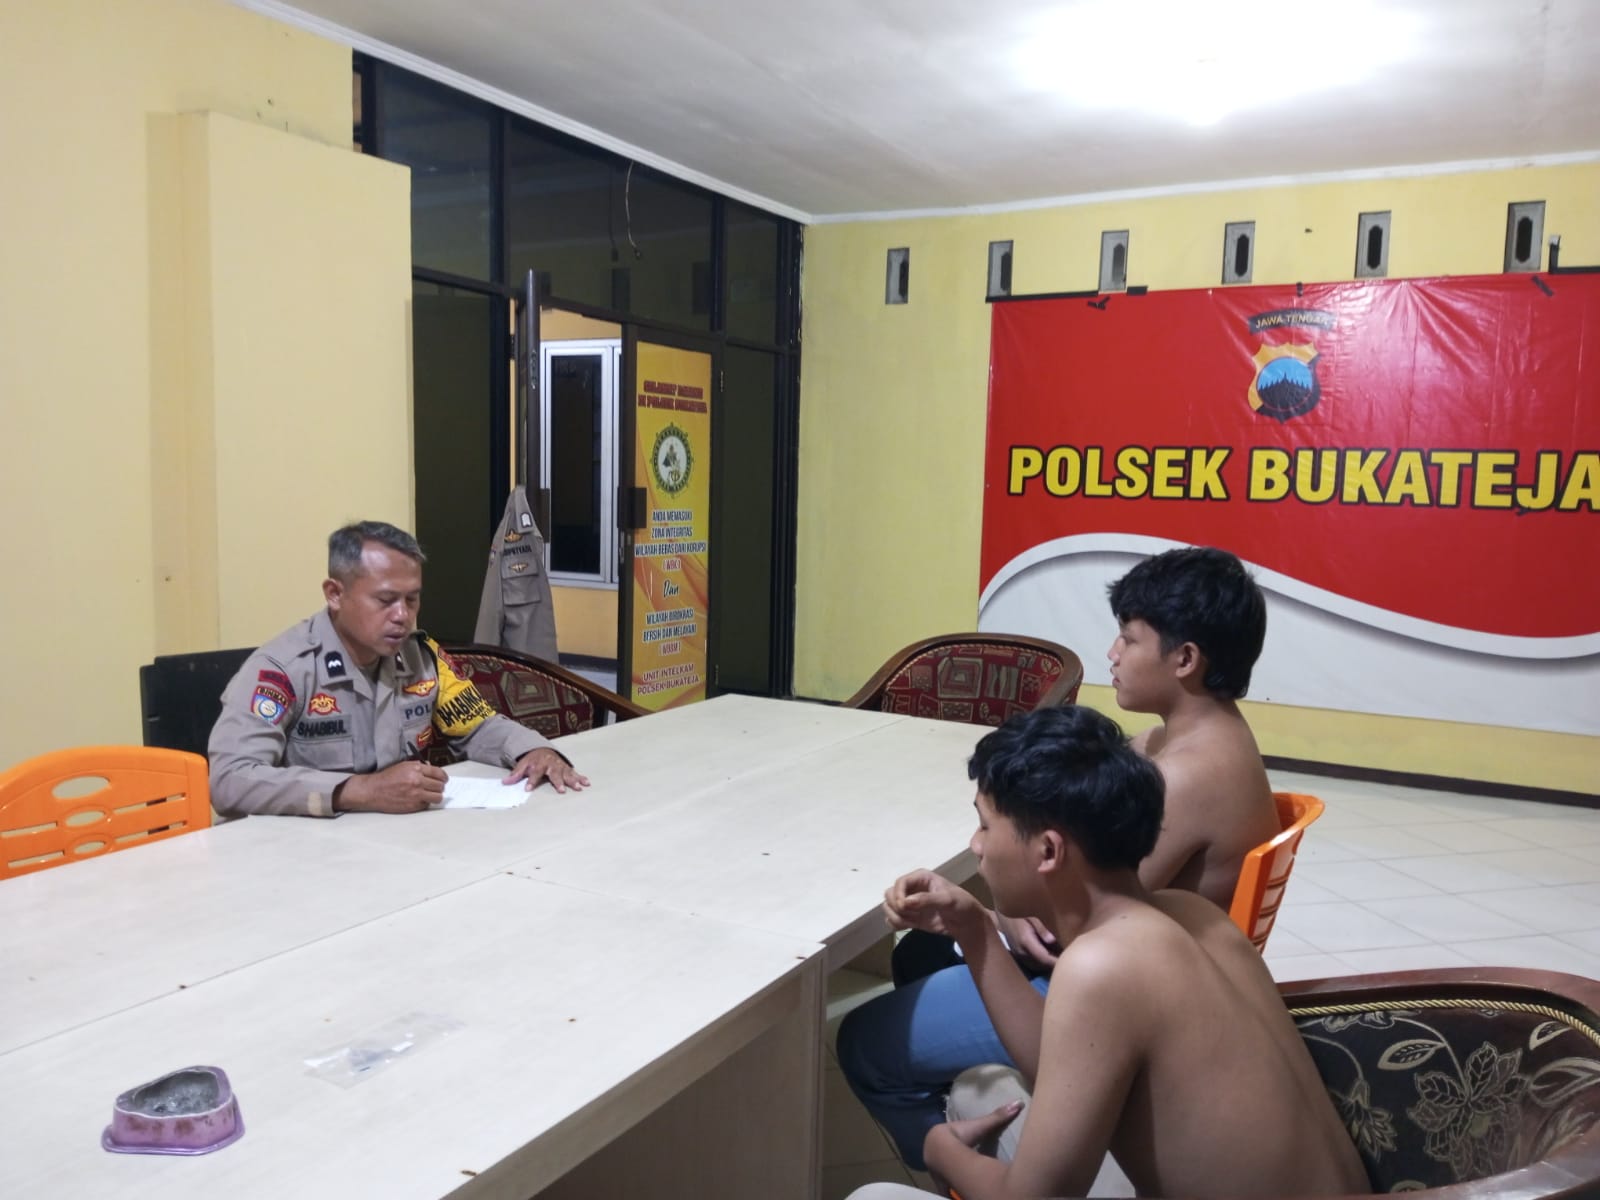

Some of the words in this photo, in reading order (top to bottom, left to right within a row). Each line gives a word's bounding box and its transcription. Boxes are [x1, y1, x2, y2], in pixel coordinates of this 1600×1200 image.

[1255, 315, 1283, 329] JAWA
[1007, 445, 1232, 501] POLSEK
[1248, 448, 1600, 512] BUKATEJA
[664, 579, 679, 598] Dan
[643, 670, 660, 682] UNIT
[661, 663, 695, 678] INTELKAM
[637, 682, 665, 697] POLSEK
[666, 675, 700, 690] BUKATEJA
